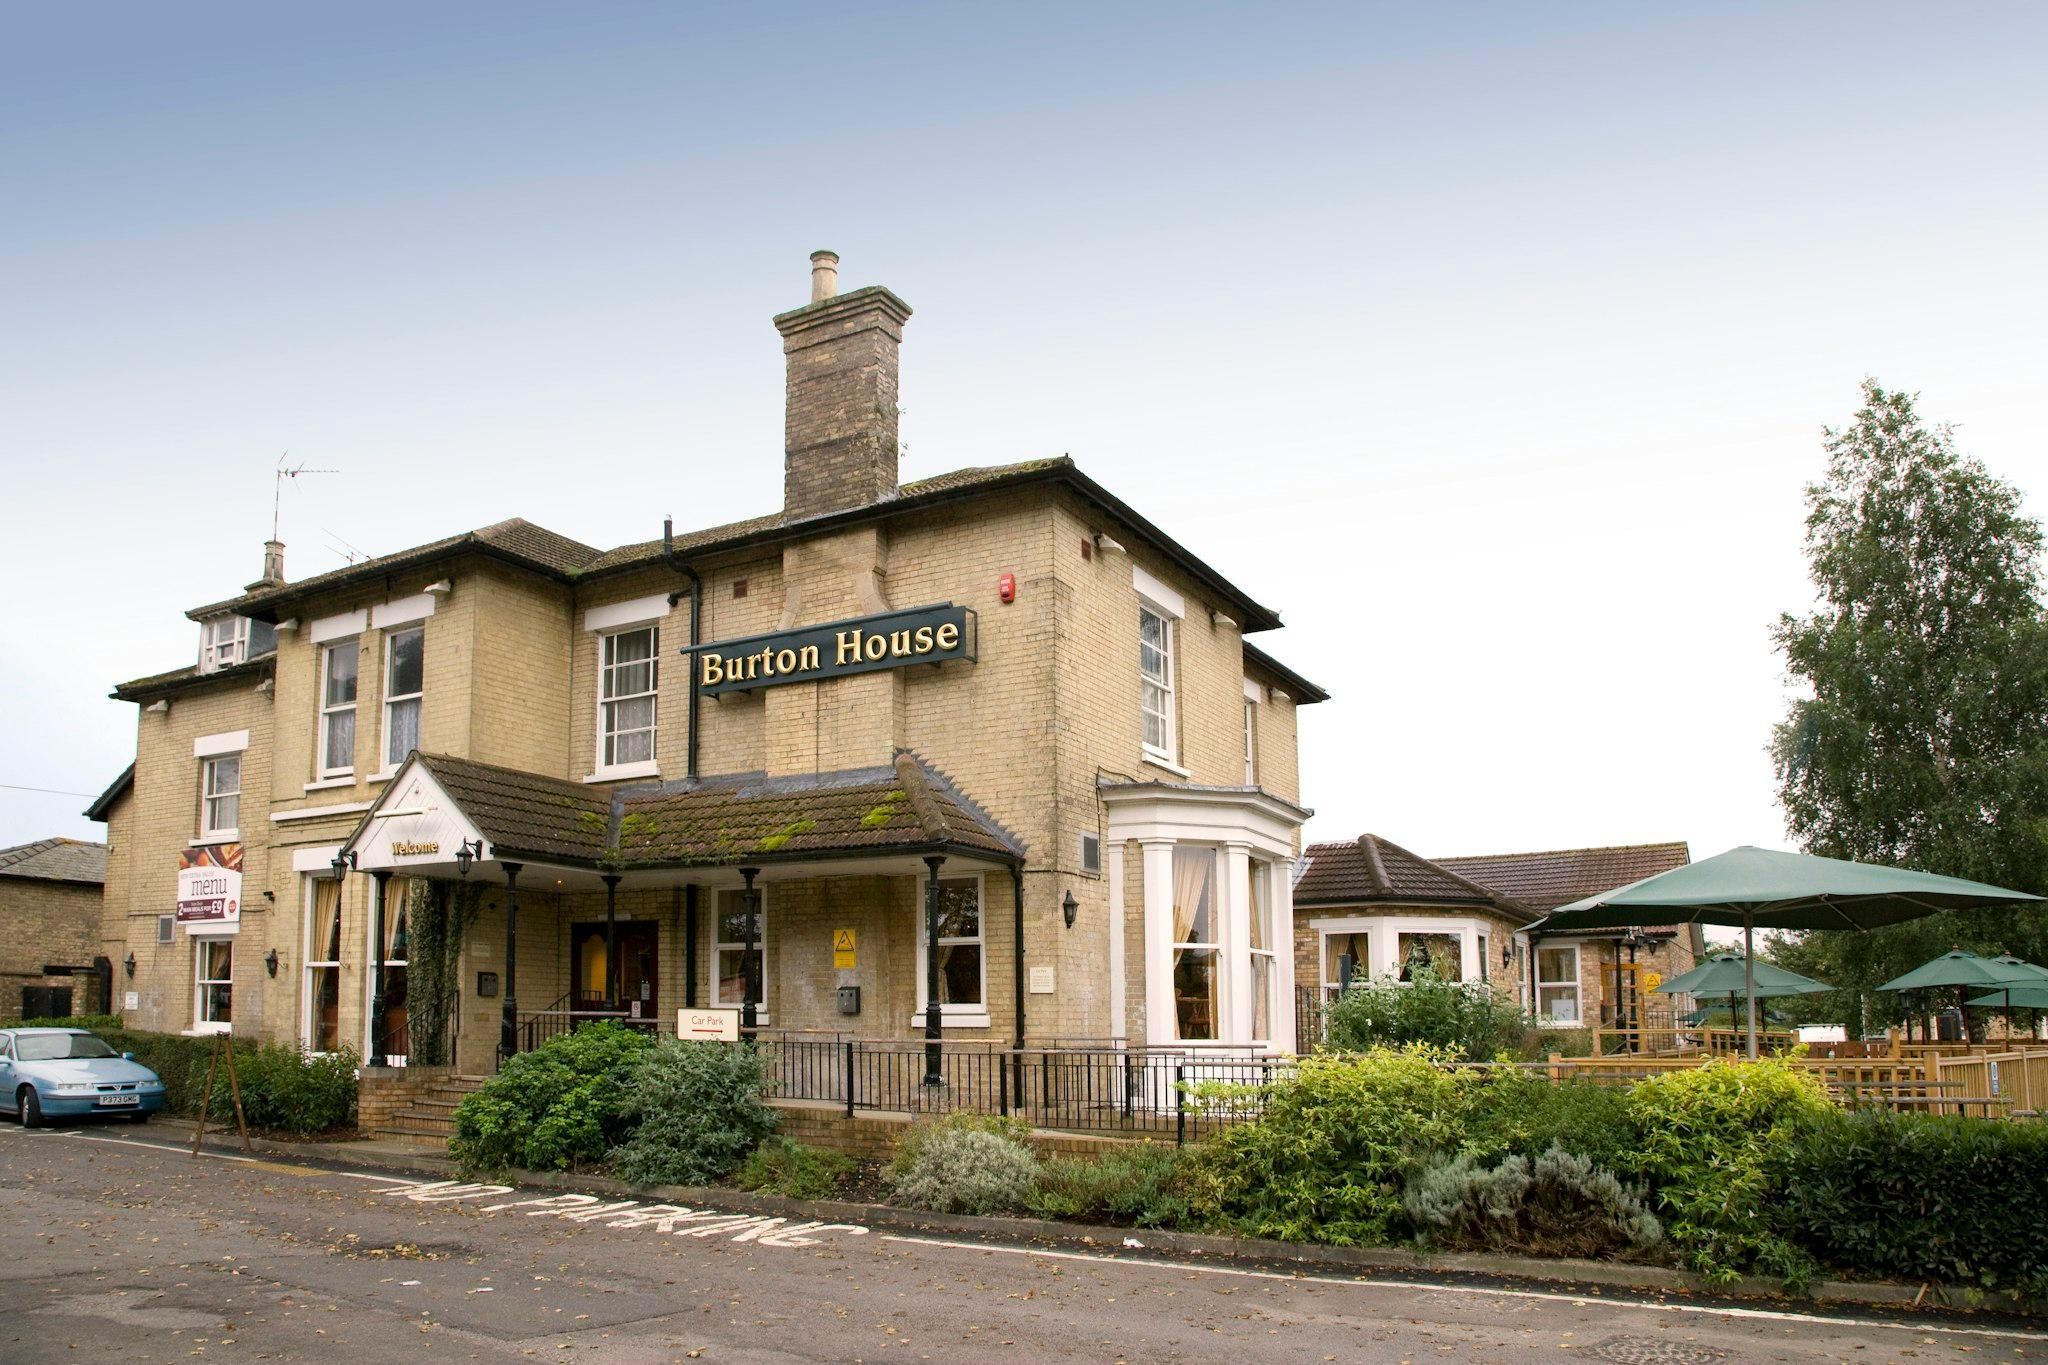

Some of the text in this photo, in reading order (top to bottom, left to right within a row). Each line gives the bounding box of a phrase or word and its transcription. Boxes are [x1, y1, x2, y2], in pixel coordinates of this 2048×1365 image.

[701, 622, 959, 686] Burton House
[392, 841, 439, 855] Welcome
[191, 878, 227, 896] menu
[178, 903, 184, 916] 2
[211, 900, 222, 914] £9
[692, 1016, 723, 1026] Car Park
[103, 1096, 122, 1104] P373
[480, 1194, 870, 1247] PARKING
